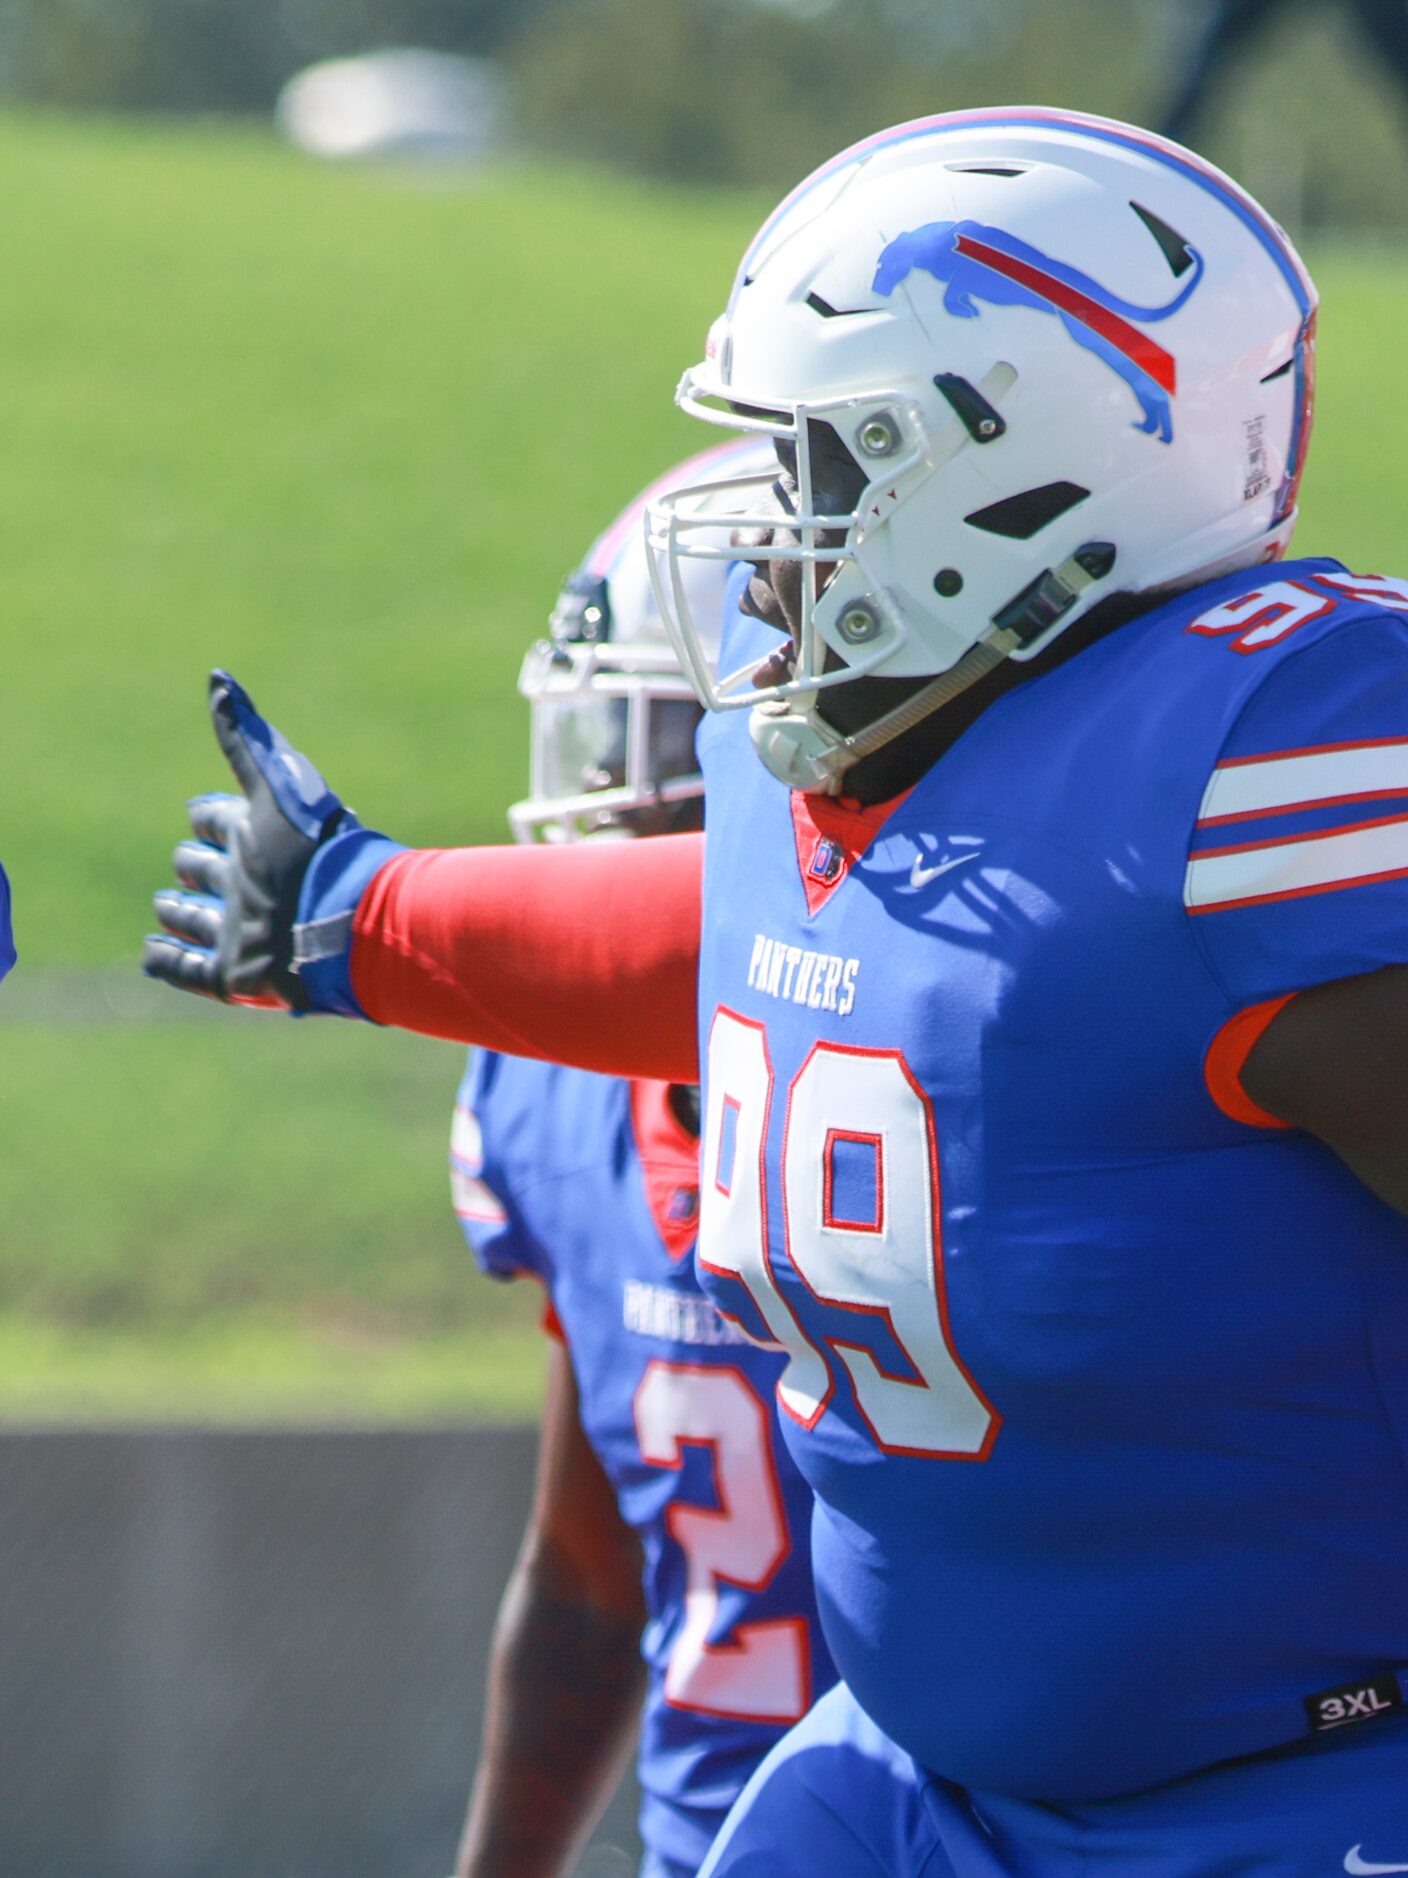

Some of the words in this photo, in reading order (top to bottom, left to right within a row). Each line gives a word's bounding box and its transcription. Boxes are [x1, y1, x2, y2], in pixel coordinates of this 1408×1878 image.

[747, 934, 860, 1016] PANTHERS
[698, 1003, 1004, 1462] 99
[632, 1358, 813, 1725] 2
[1319, 1688, 1392, 1720] 3XL
